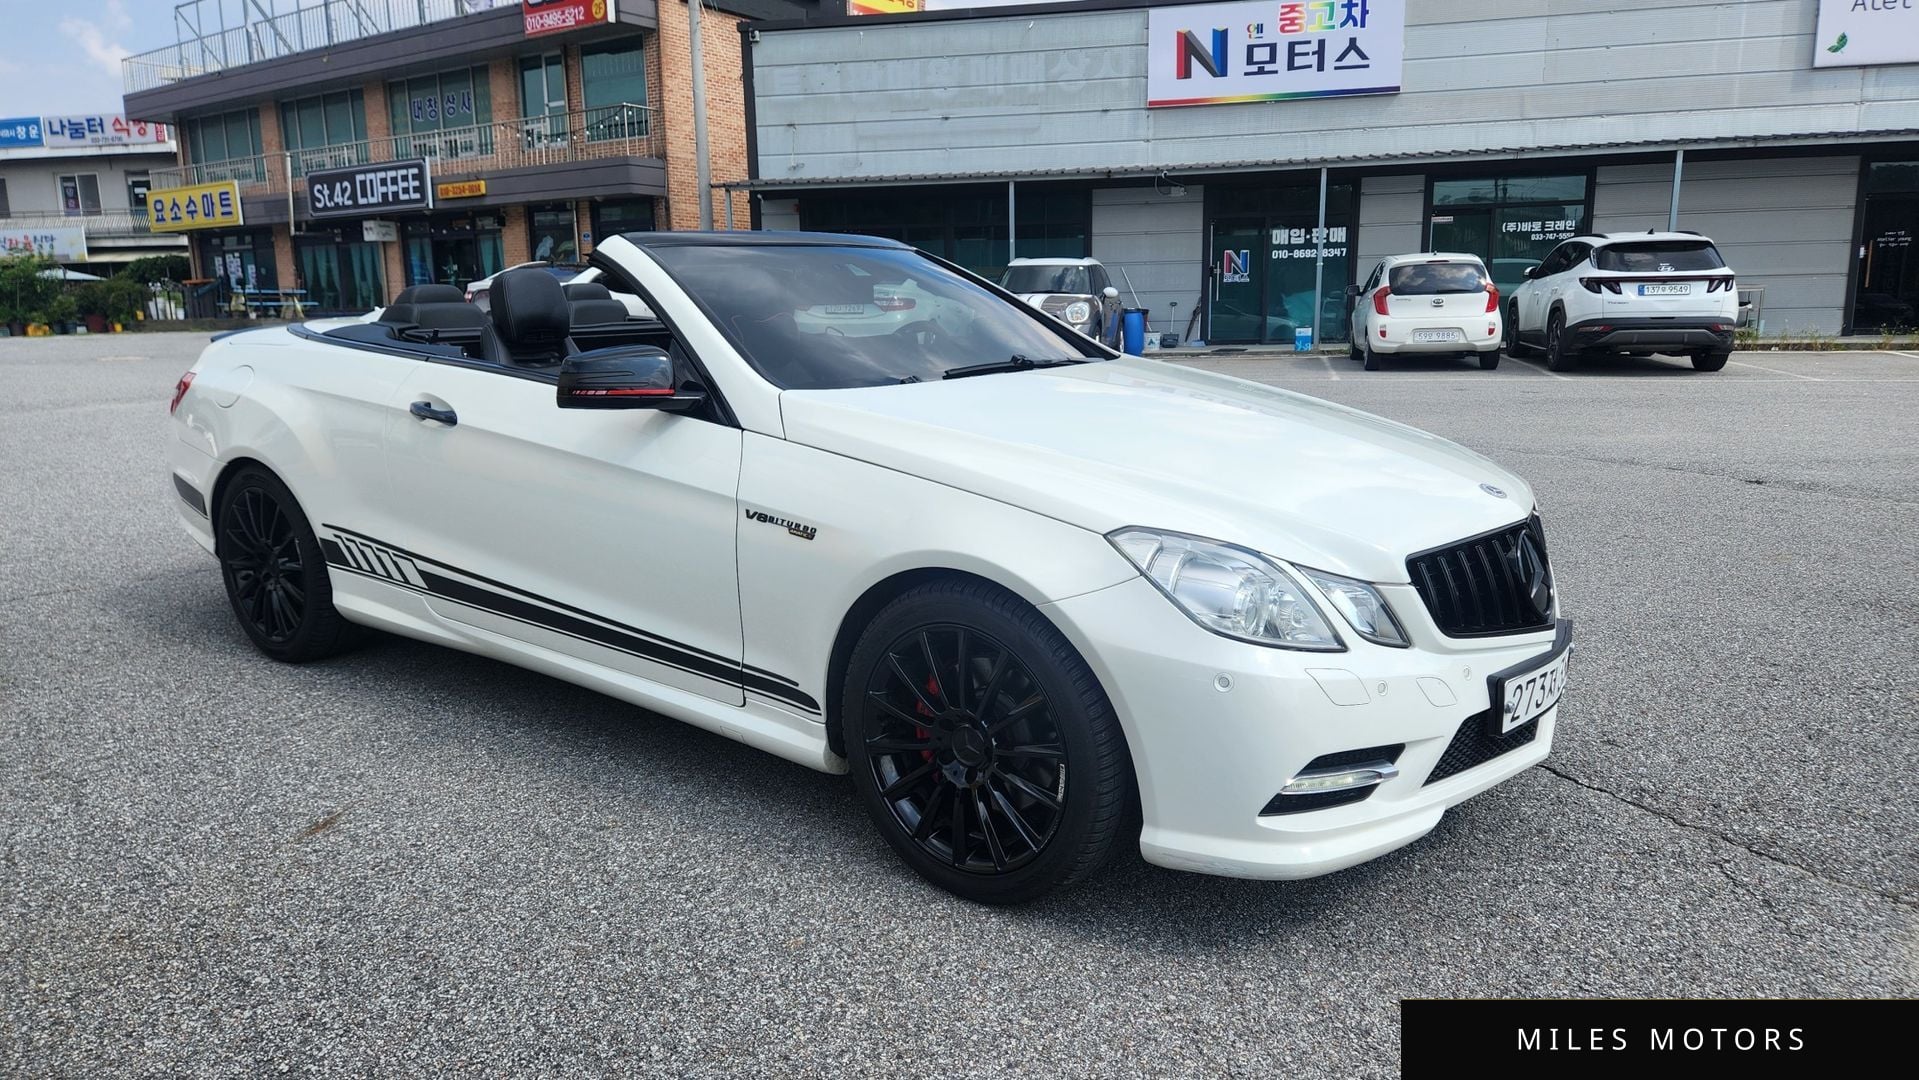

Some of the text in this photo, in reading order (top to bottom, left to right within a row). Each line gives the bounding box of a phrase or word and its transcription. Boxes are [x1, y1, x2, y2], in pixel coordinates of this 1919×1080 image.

[1279, 0, 1370, 34] 중고차
[1247, 23, 1264, 39] 엔
[1176, 27, 1228, 80] N
[1243, 37, 1370, 76] 모터스
[48, 117, 105, 140] 나눔터
[313, 167, 421, 209] St.42 COFFEE
[153, 191, 234, 223] 요소수마트
[1502, 220, 1576, 233] (주)바로 크레인
[1272, 248, 1347, 260] 010-86928347
[1668, 285, 1688, 294] 9549
